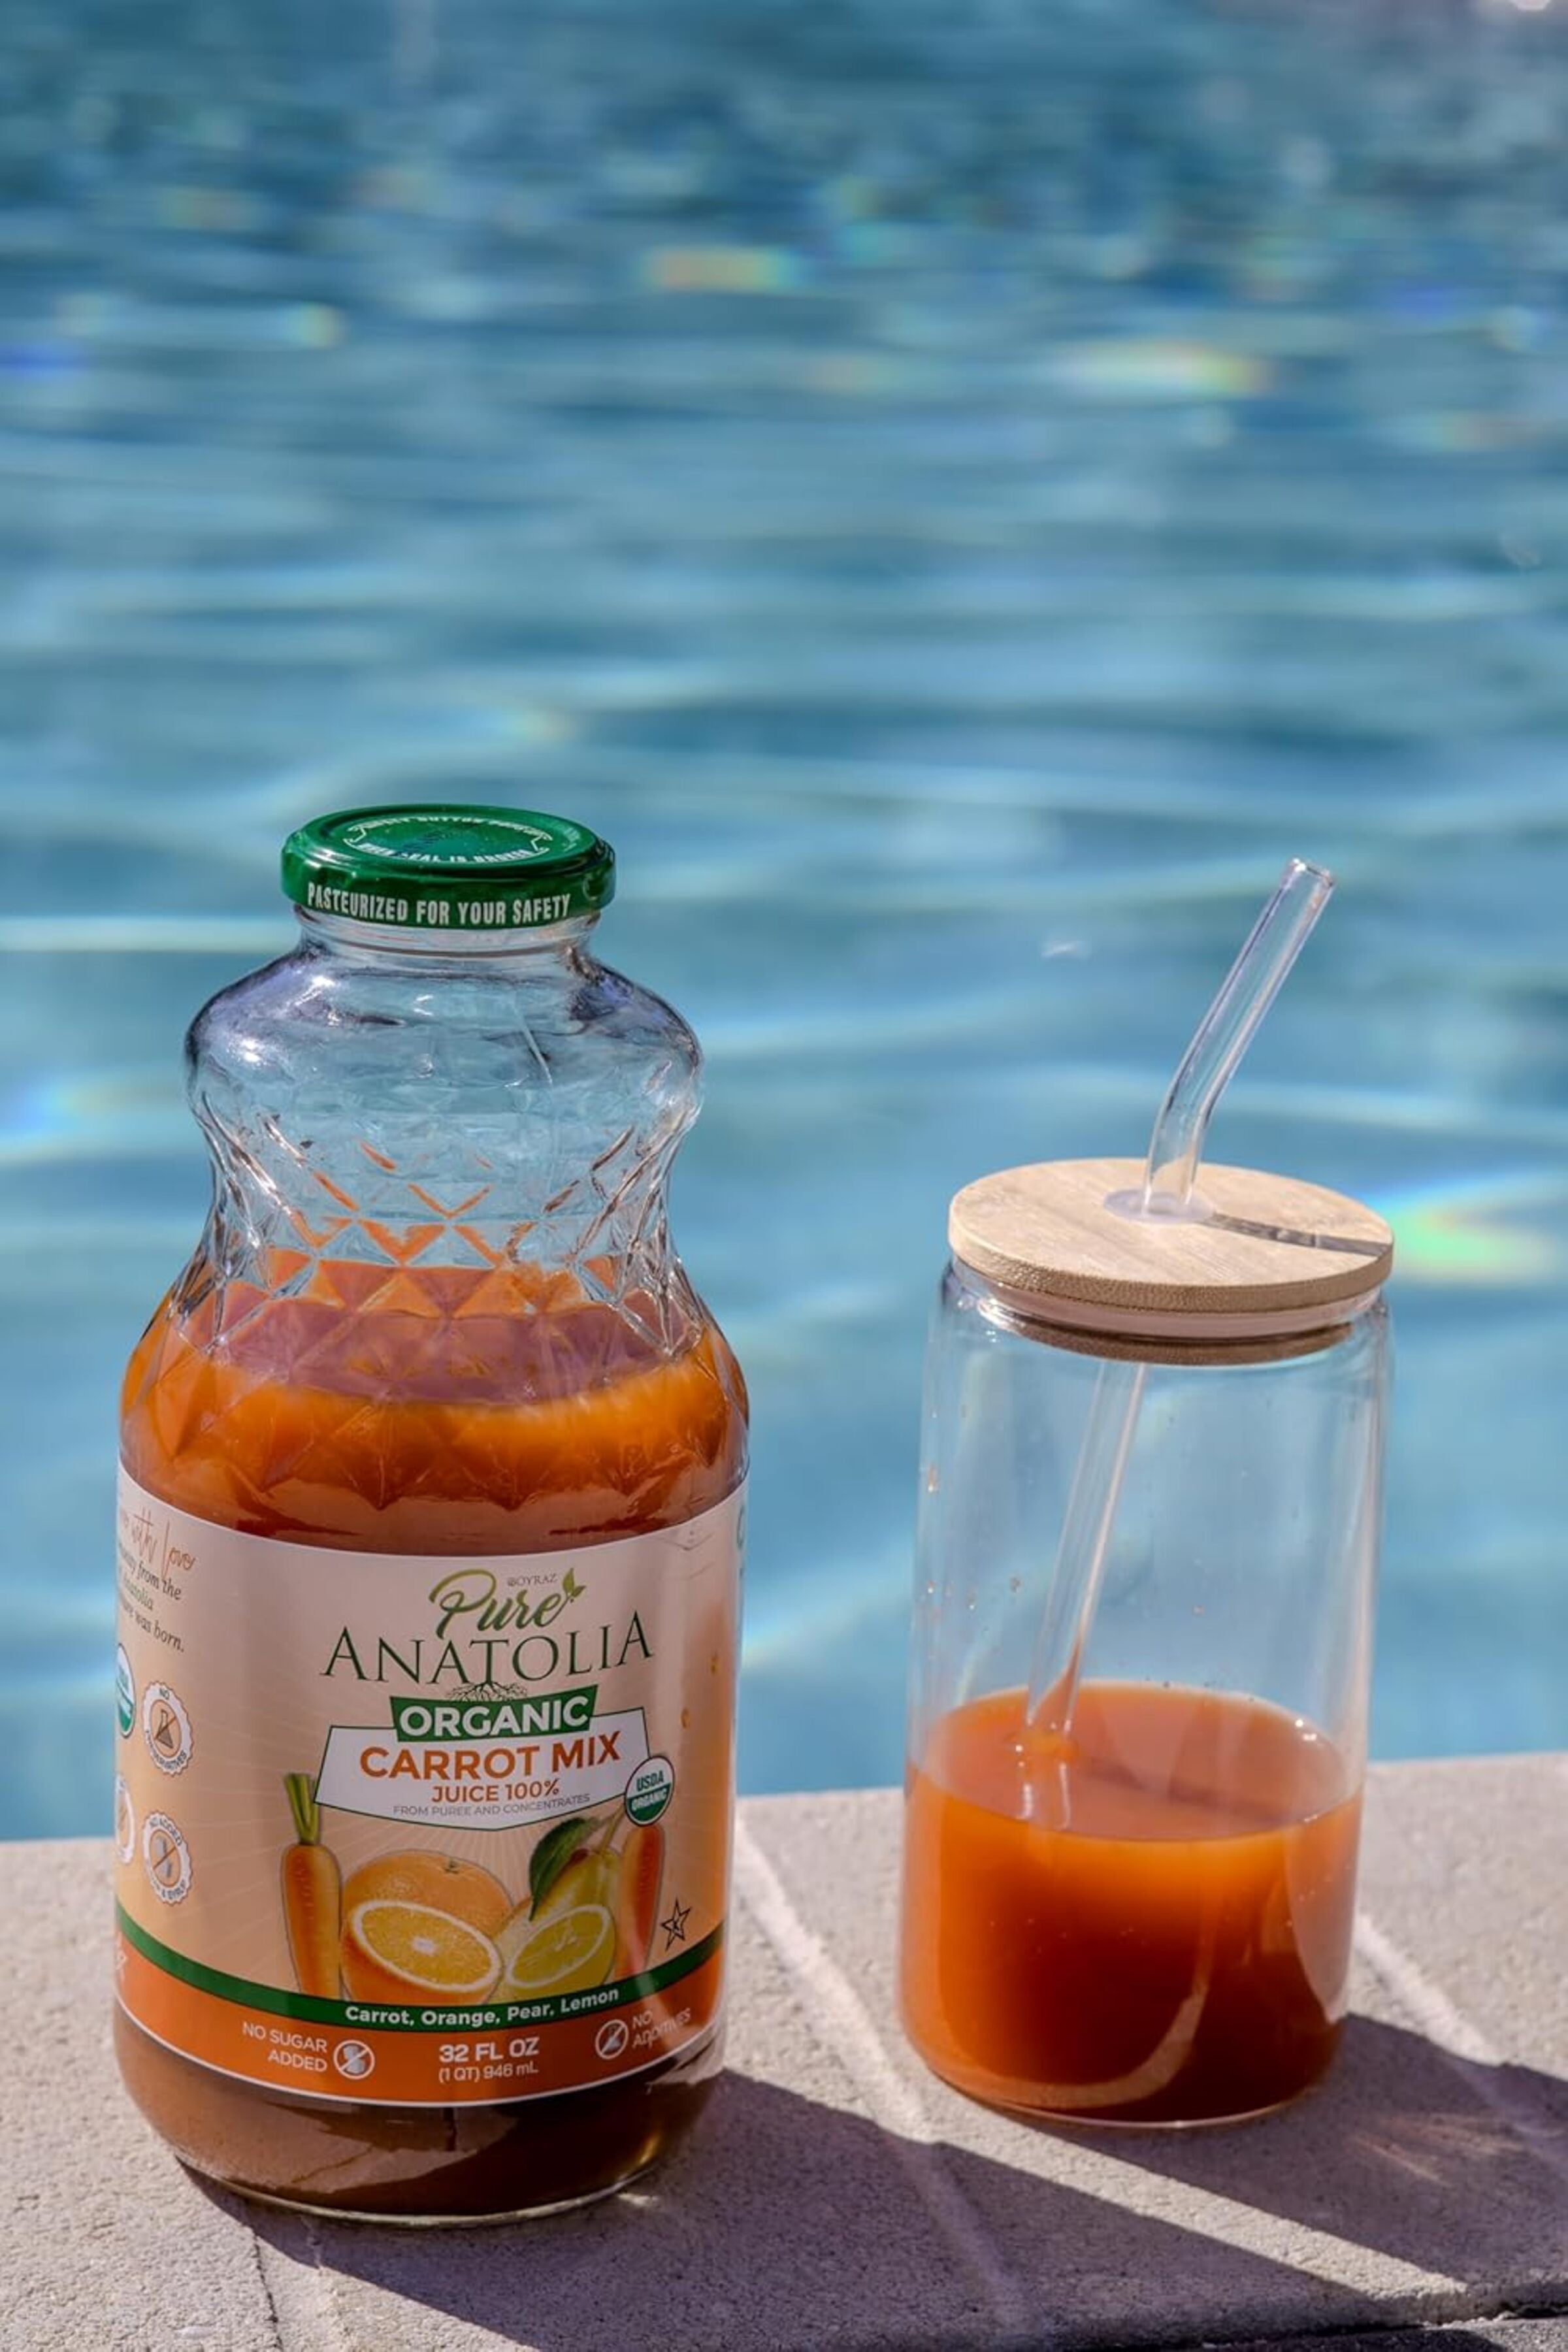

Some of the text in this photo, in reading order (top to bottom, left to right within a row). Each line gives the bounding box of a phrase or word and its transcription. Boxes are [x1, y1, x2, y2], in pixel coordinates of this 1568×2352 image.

[308, 882, 571, 926] PASTEURIZED FOR YOUR SAFETY
[137, 1561, 182, 1601] from the
[429, 1569, 573, 1639] Pure
[154, 1619, 185, 1653] born.
[319, 1611, 653, 1684] ANATOLIA
[399, 1696, 588, 1737] ORGANIC
[359, 1731, 621, 1781] CARROT MIX
[431, 1778, 559, 1803] JUICE 100%
[636, 1770, 664, 1792] USDA
[393, 1794, 591, 1816] FROM PUREE AND CONCENTRATES
[346, 2006, 414, 2025] Carrot,
[421, 2010, 500, 2026] Orange,
[561, 1988, 619, 2012] Lemon
[632, 2010, 653, 2029] NO
[242, 2021, 327, 2053] NO SUGAR
[439, 2036, 540, 2063] 32 FL OZ
[267, 2049, 327, 2072] ADDED
[455, 2068, 480, 2082] QT)
[483, 2065, 513, 2080] 946
[515, 2061, 539, 2076] mL
